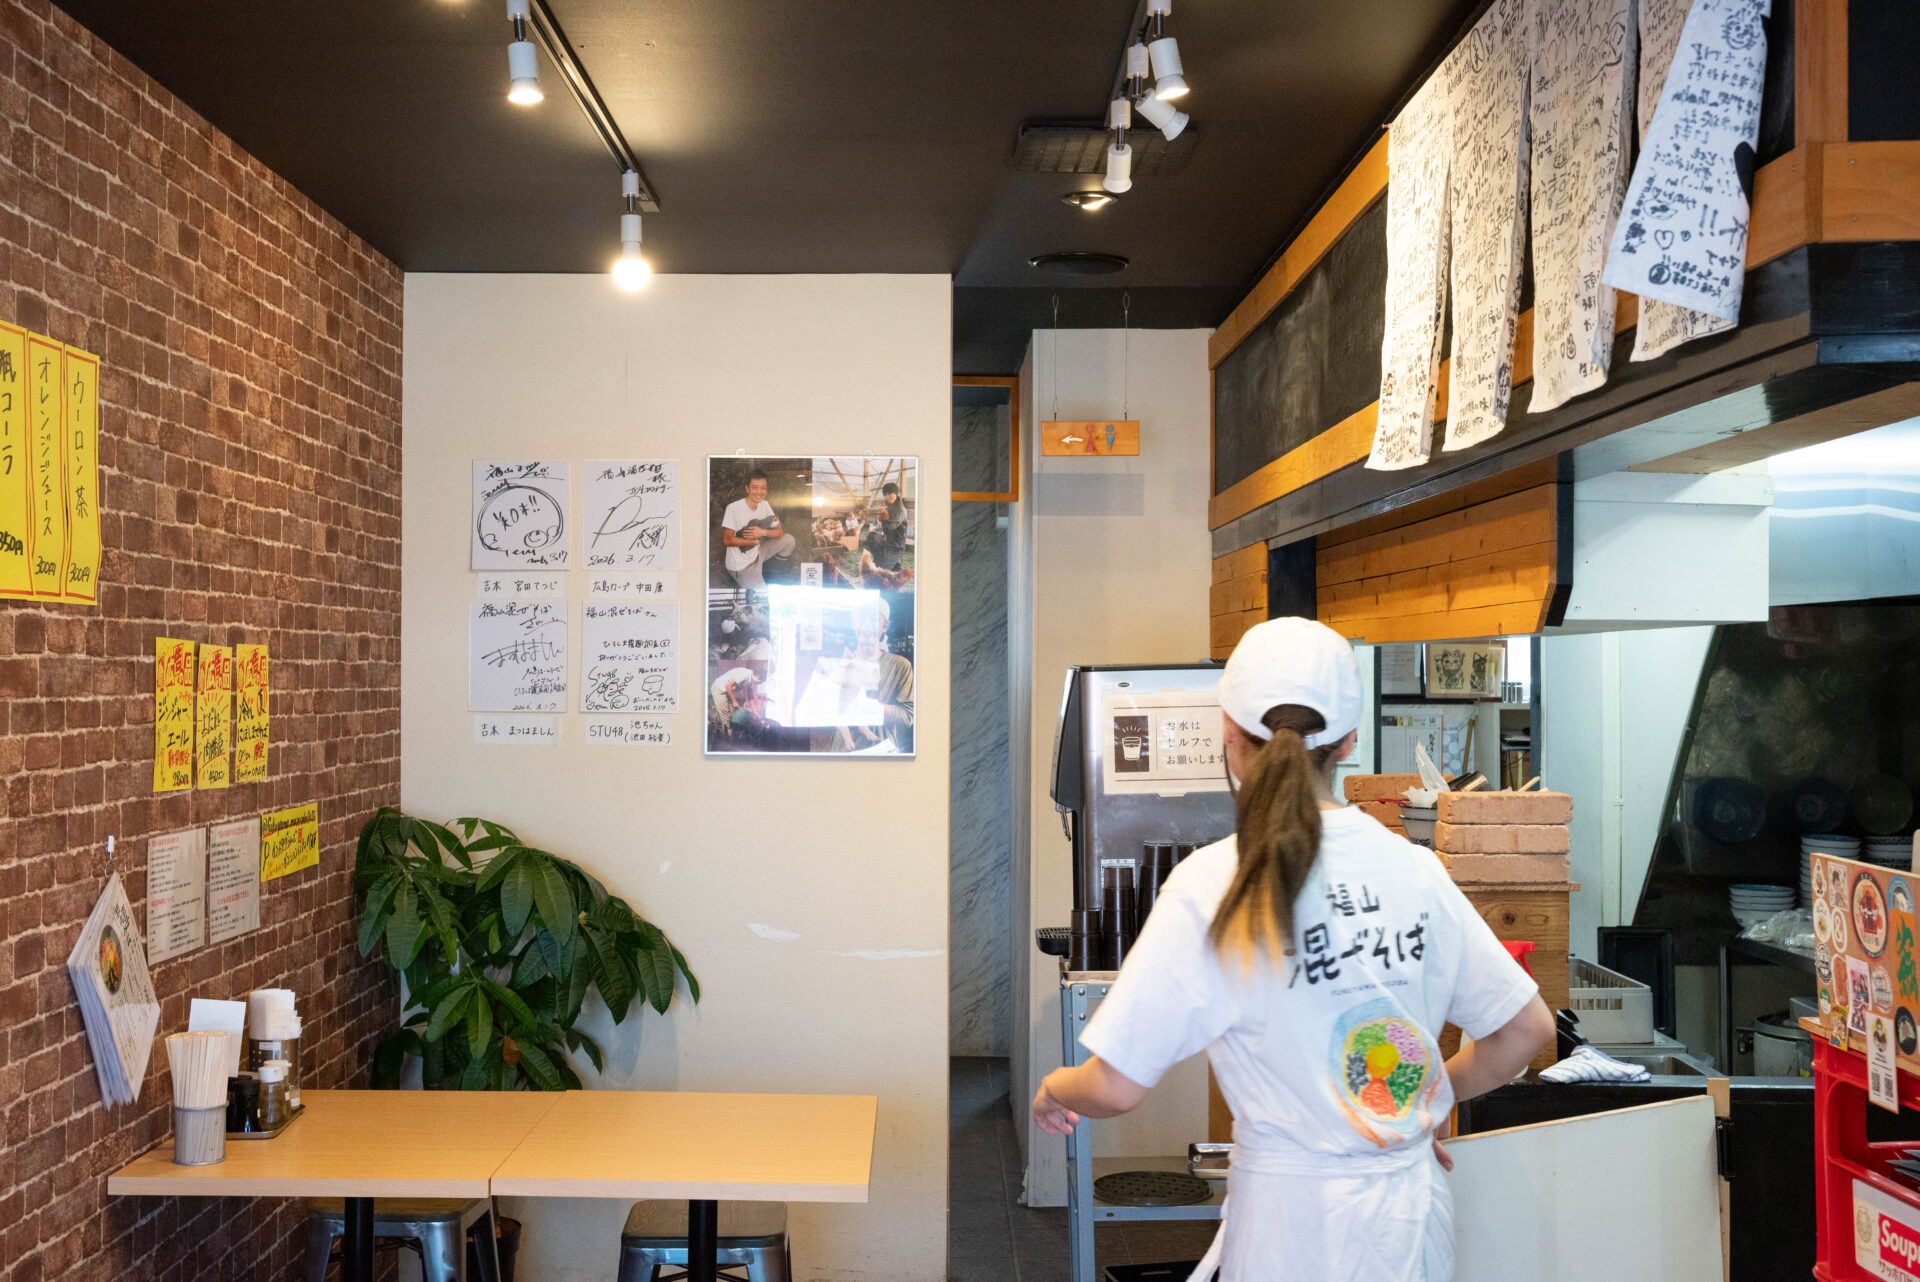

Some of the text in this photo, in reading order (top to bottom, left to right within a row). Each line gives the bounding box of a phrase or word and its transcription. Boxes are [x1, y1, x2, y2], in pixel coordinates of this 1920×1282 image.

[37, 356, 53, 537] オレンジジュース
[72, 371, 89, 520] ウーロン茶
[34, 555, 57, 577] 300円
[69, 562, 91, 583] 300円
[483, 580, 558, 592] 吉本 宮田てつじ
[593, 580, 631, 593] 広島カープ
[157, 695, 190, 723] ジンジャー
[481, 722, 554, 736] 吉本 まつはましん
[589, 720, 663, 738] STU48 池ちゃん
[1167, 720, 1201, 732] お水は
[167, 730, 191, 749] エール
[1167, 737, 1212, 749] セルフで
[1166, 754, 1225, 766] お願いします
[1325, 882, 1381, 917] 福山
[1288, 911, 1430, 990] 混ぜそば
[1881, 1218, 1920, 1269] Soup
